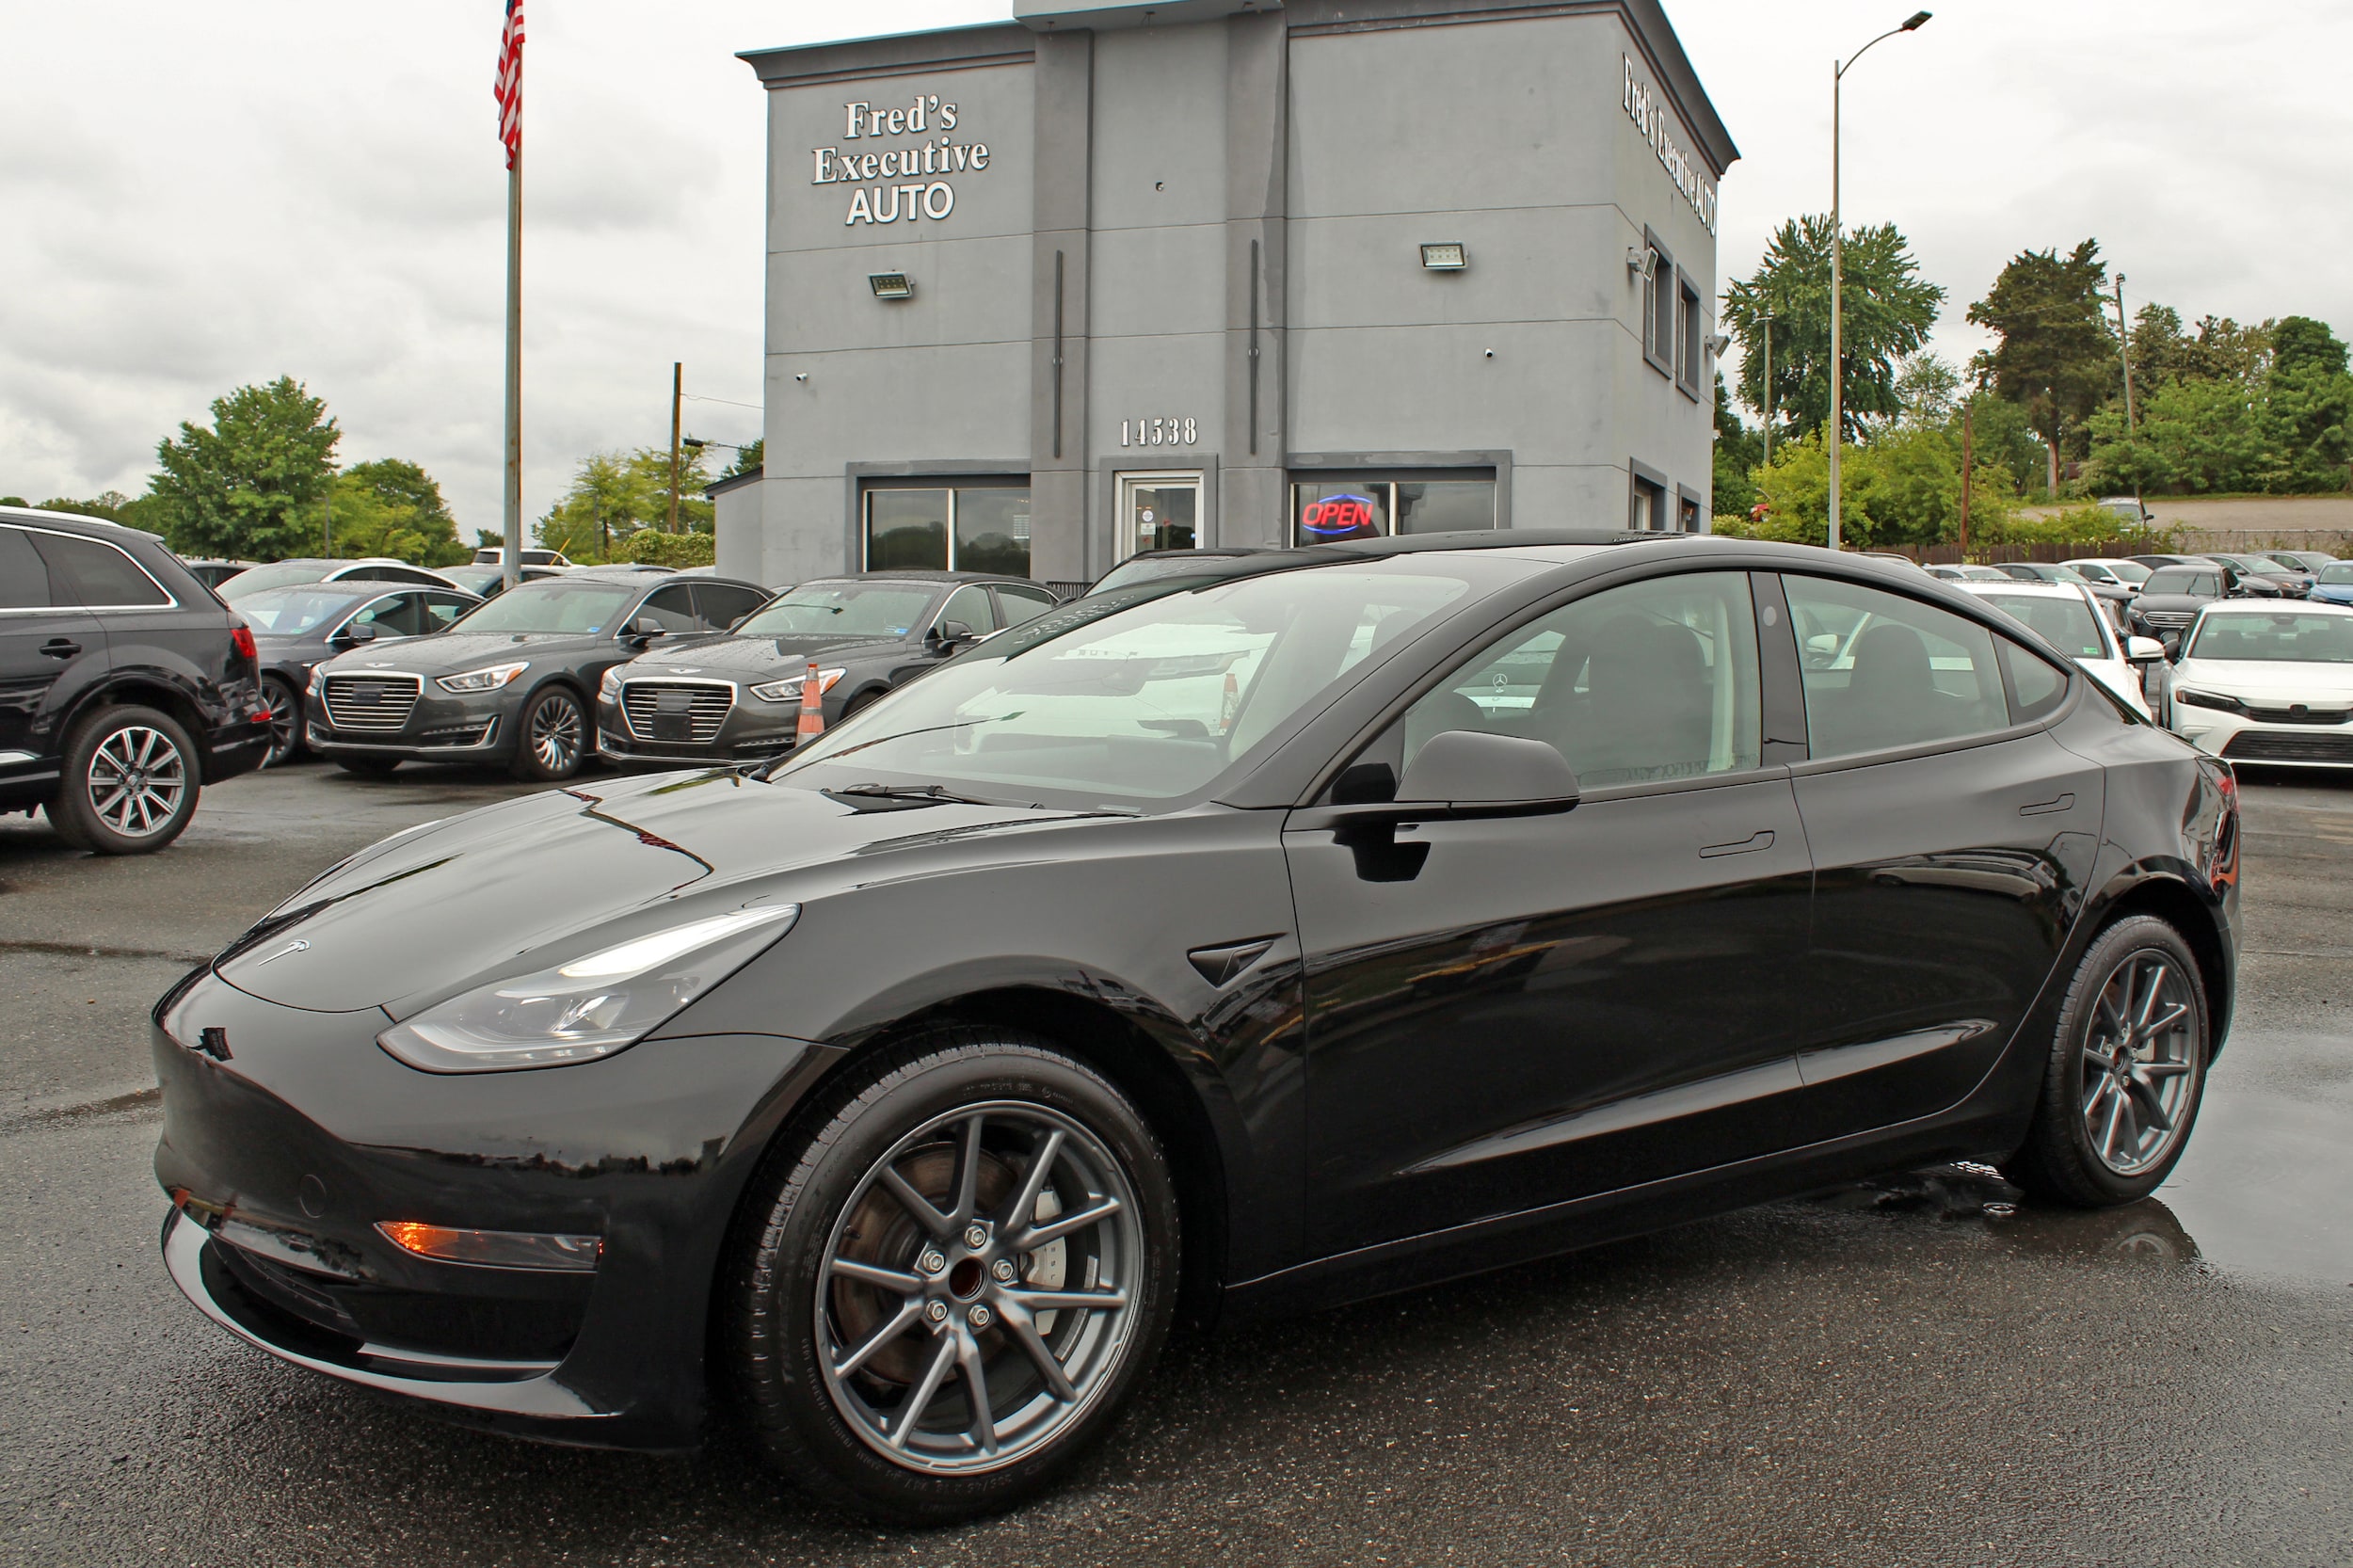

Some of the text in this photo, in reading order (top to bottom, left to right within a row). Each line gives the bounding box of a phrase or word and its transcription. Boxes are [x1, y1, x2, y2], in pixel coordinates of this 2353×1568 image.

[844, 94, 957, 139] Fred's
[812, 137, 989, 184] Executive
[1623, 53, 1716, 237] Fred's Executive AUTO
[846, 182, 954, 226] AUTO
[1121, 417, 1197, 446] 14538
[1303, 503, 1373, 526] OPEN
